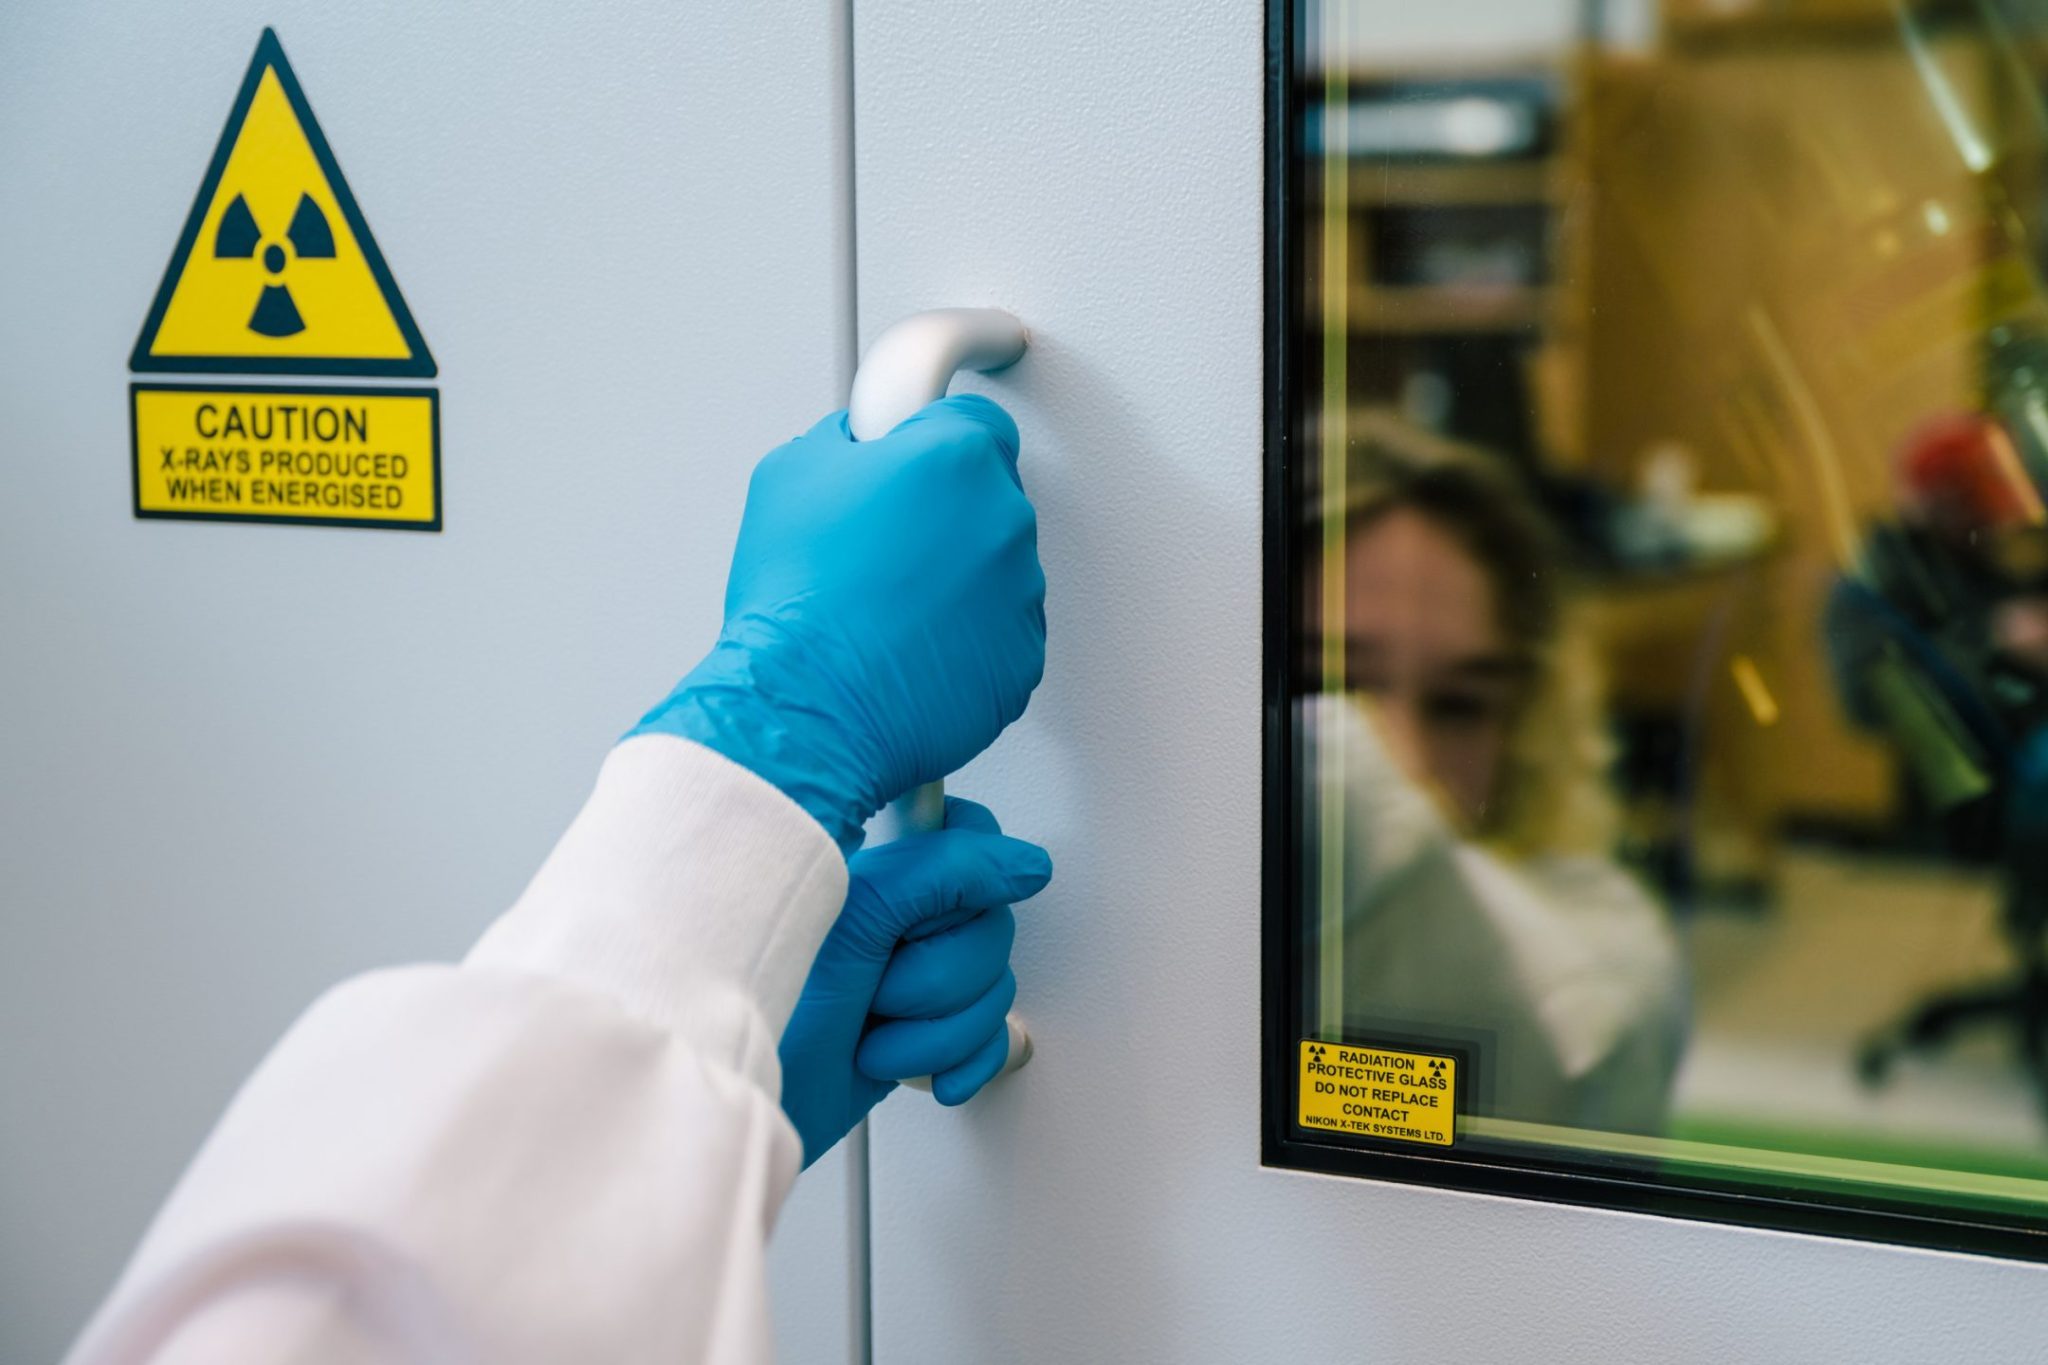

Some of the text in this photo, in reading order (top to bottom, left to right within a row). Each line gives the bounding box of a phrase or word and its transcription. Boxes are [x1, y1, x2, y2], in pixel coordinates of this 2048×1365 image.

[195, 403, 368, 443] CAUTION
[160, 447, 408, 479] X-RAYS PRODUCED
[166, 478, 402, 509] WHEN ENERGISED
[1340, 1051, 1415, 1070] RADIATION
[1307, 1062, 1447, 1090] PROTECTIVE GLASS
[1315, 1082, 1438, 1108] DO NOT REPLACE
[1342, 1103, 1409, 1122] CONTACT
[1306, 1115, 1446, 1142] NIKON X-TEK SYSTEMS LTD.
